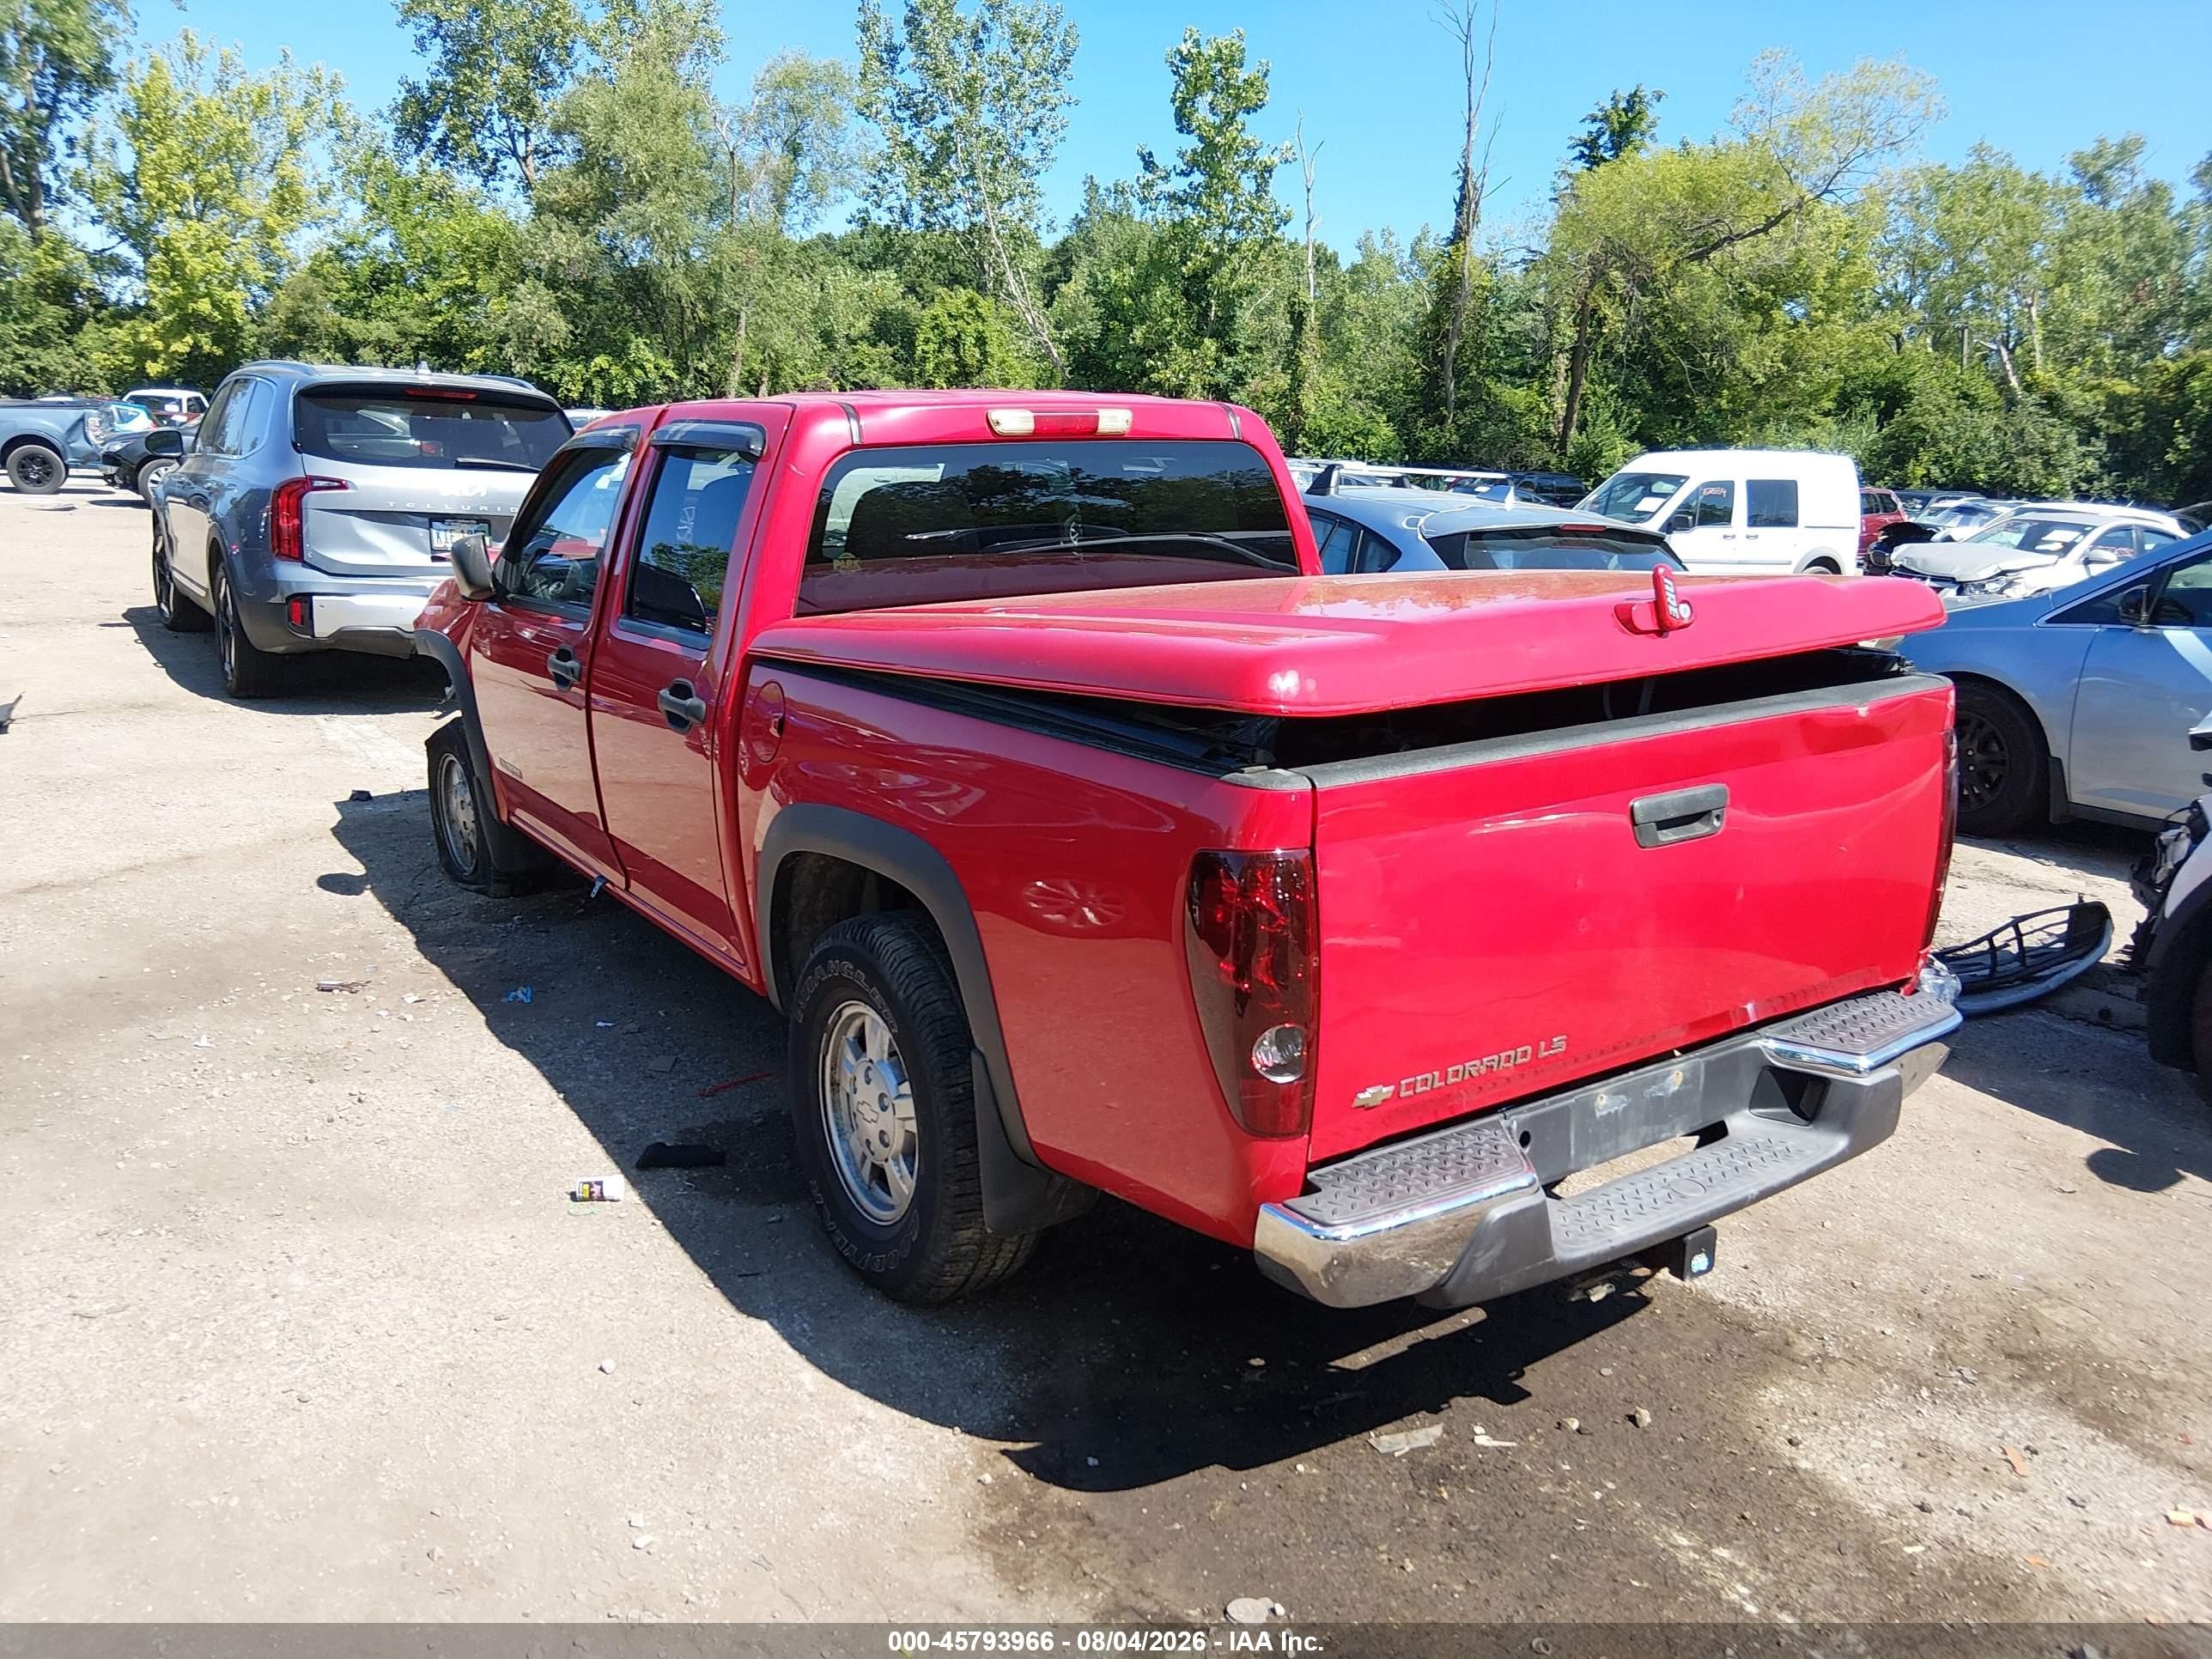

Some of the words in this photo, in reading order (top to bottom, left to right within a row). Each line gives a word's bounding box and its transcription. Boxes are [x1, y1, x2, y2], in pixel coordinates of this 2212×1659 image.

[387, 501, 519, 513] TELLURID
[1398, 1044, 1533, 1099] COLORADO
[1538, 1035, 1567, 1059] LS
